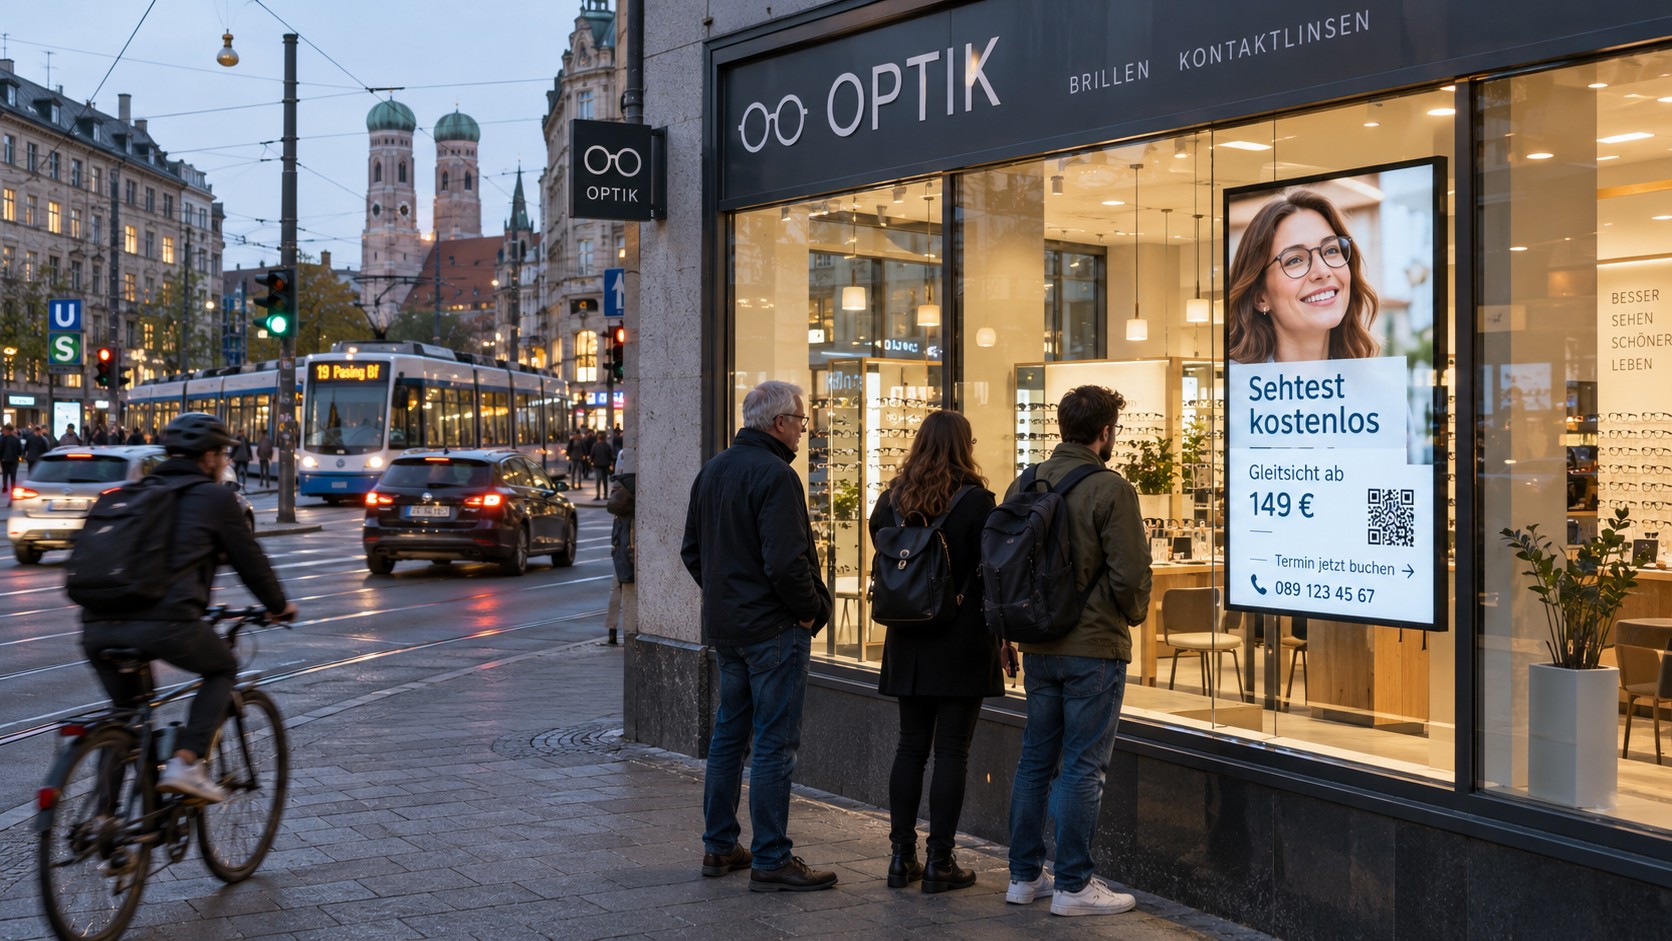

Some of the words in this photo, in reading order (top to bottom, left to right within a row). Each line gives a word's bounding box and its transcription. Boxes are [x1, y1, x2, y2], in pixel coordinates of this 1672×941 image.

[1069, 59, 1149, 94] BRILLEN
[1179, 9, 1370, 71] KONTAKTLINSEN
[826, 35, 1001, 137] OPTIK
[586, 185, 638, 203] OPTIK
[1611, 288, 1660, 304] BESSER
[55, 303, 75, 327] U
[1611, 312, 1653, 327] SEHEN
[55, 335, 74, 361] S
[1611, 332, 1672, 349] SCHÖNER
[316, 364, 330, 379] 19
[333, 364, 366, 381] Pasing
[367, 364, 380, 379] Bf
[1611, 357, 1653, 371] LEBEN
[1249, 373, 1345, 401] Sehtest
[1250, 406, 1380, 434] kostenlos
[1249, 464, 1320, 481] Gleitsicht
[1324, 465, 1344, 482] ab
[1249, 491, 1292, 517] 149
[1298, 492, 1315, 519] €
[1275, 553, 1315, 569] Termin
[1317, 557, 1346, 573] jetzt
[1349, 559, 1396, 576] buchen
[1275, 580, 1301, 597] 089
[1306, 583, 1331, 599] 123
[1335, 586, 1353, 602] 45
[1357, 588, 1375, 604] 67
